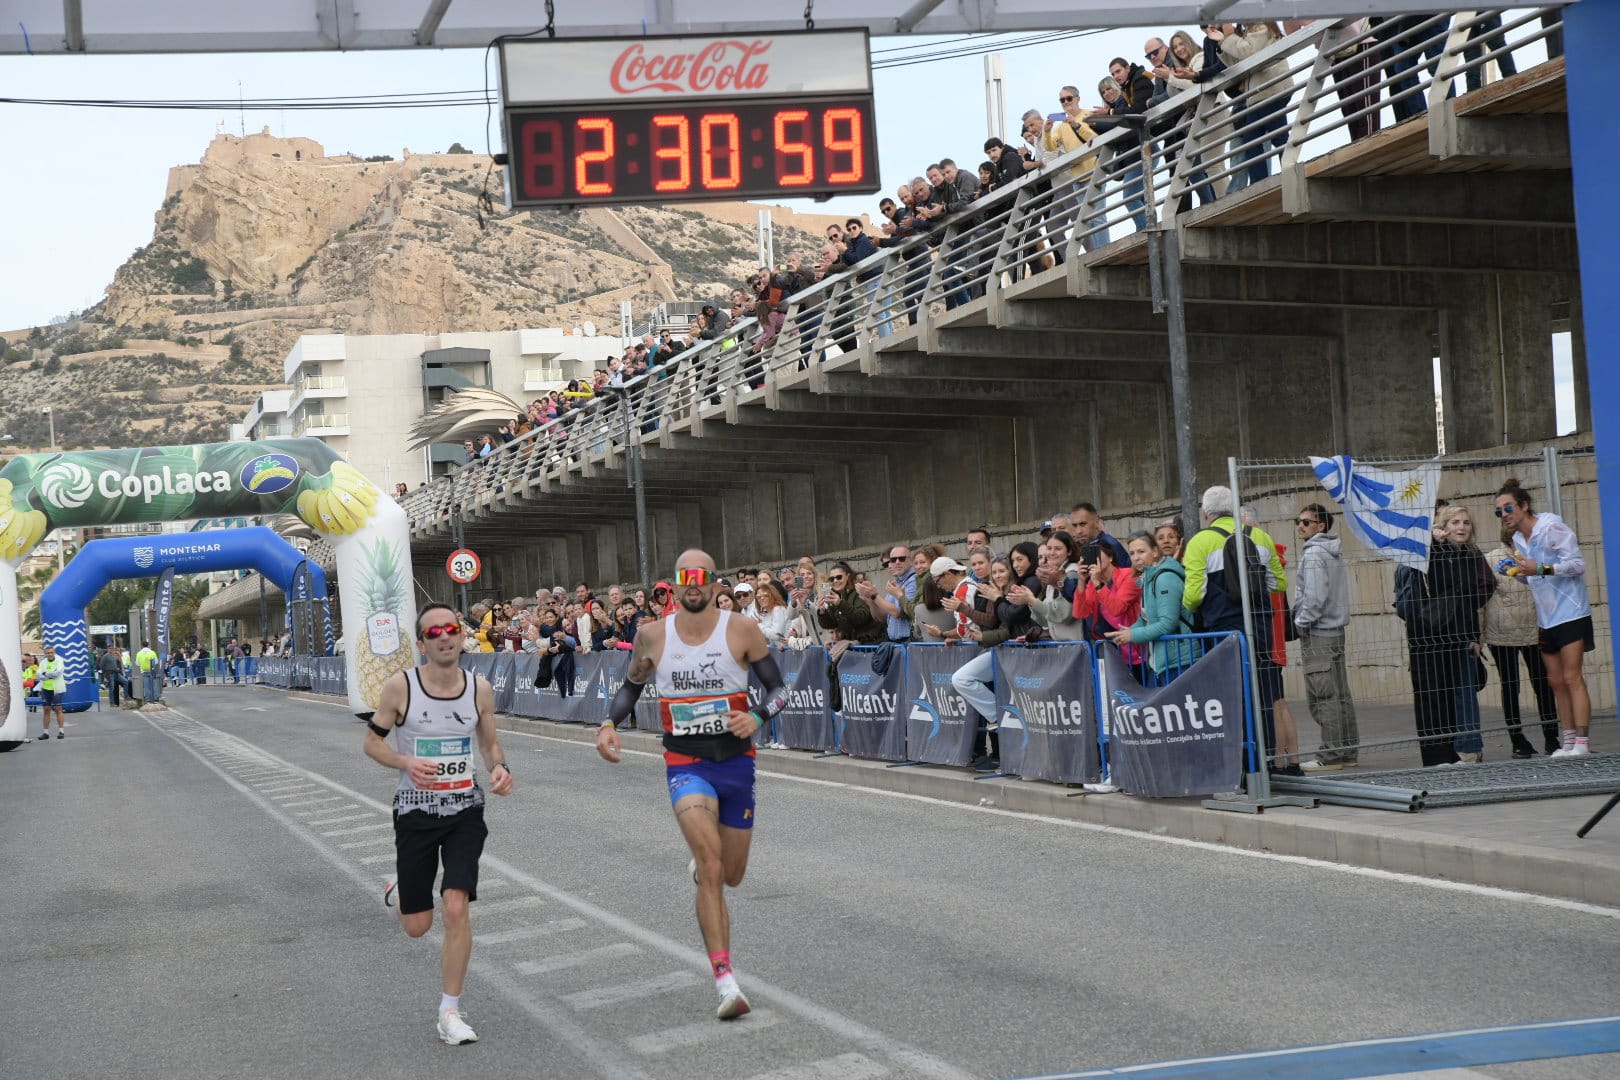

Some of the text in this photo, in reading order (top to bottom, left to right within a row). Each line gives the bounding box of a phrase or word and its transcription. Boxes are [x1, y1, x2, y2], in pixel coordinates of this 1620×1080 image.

[609, 39, 773, 95] Coca-Cola
[98, 465, 232, 504] Coplaca
[160, 543, 221, 556] MONTEMAR
[454, 560, 474, 572] 30
[157, 580, 171, 644] Alicante
[671, 670, 697, 682] BULL
[673, 679, 724, 691] RUNNERS
[1018, 691, 1082, 726] Alicante
[683, 719, 724, 735] 2768
